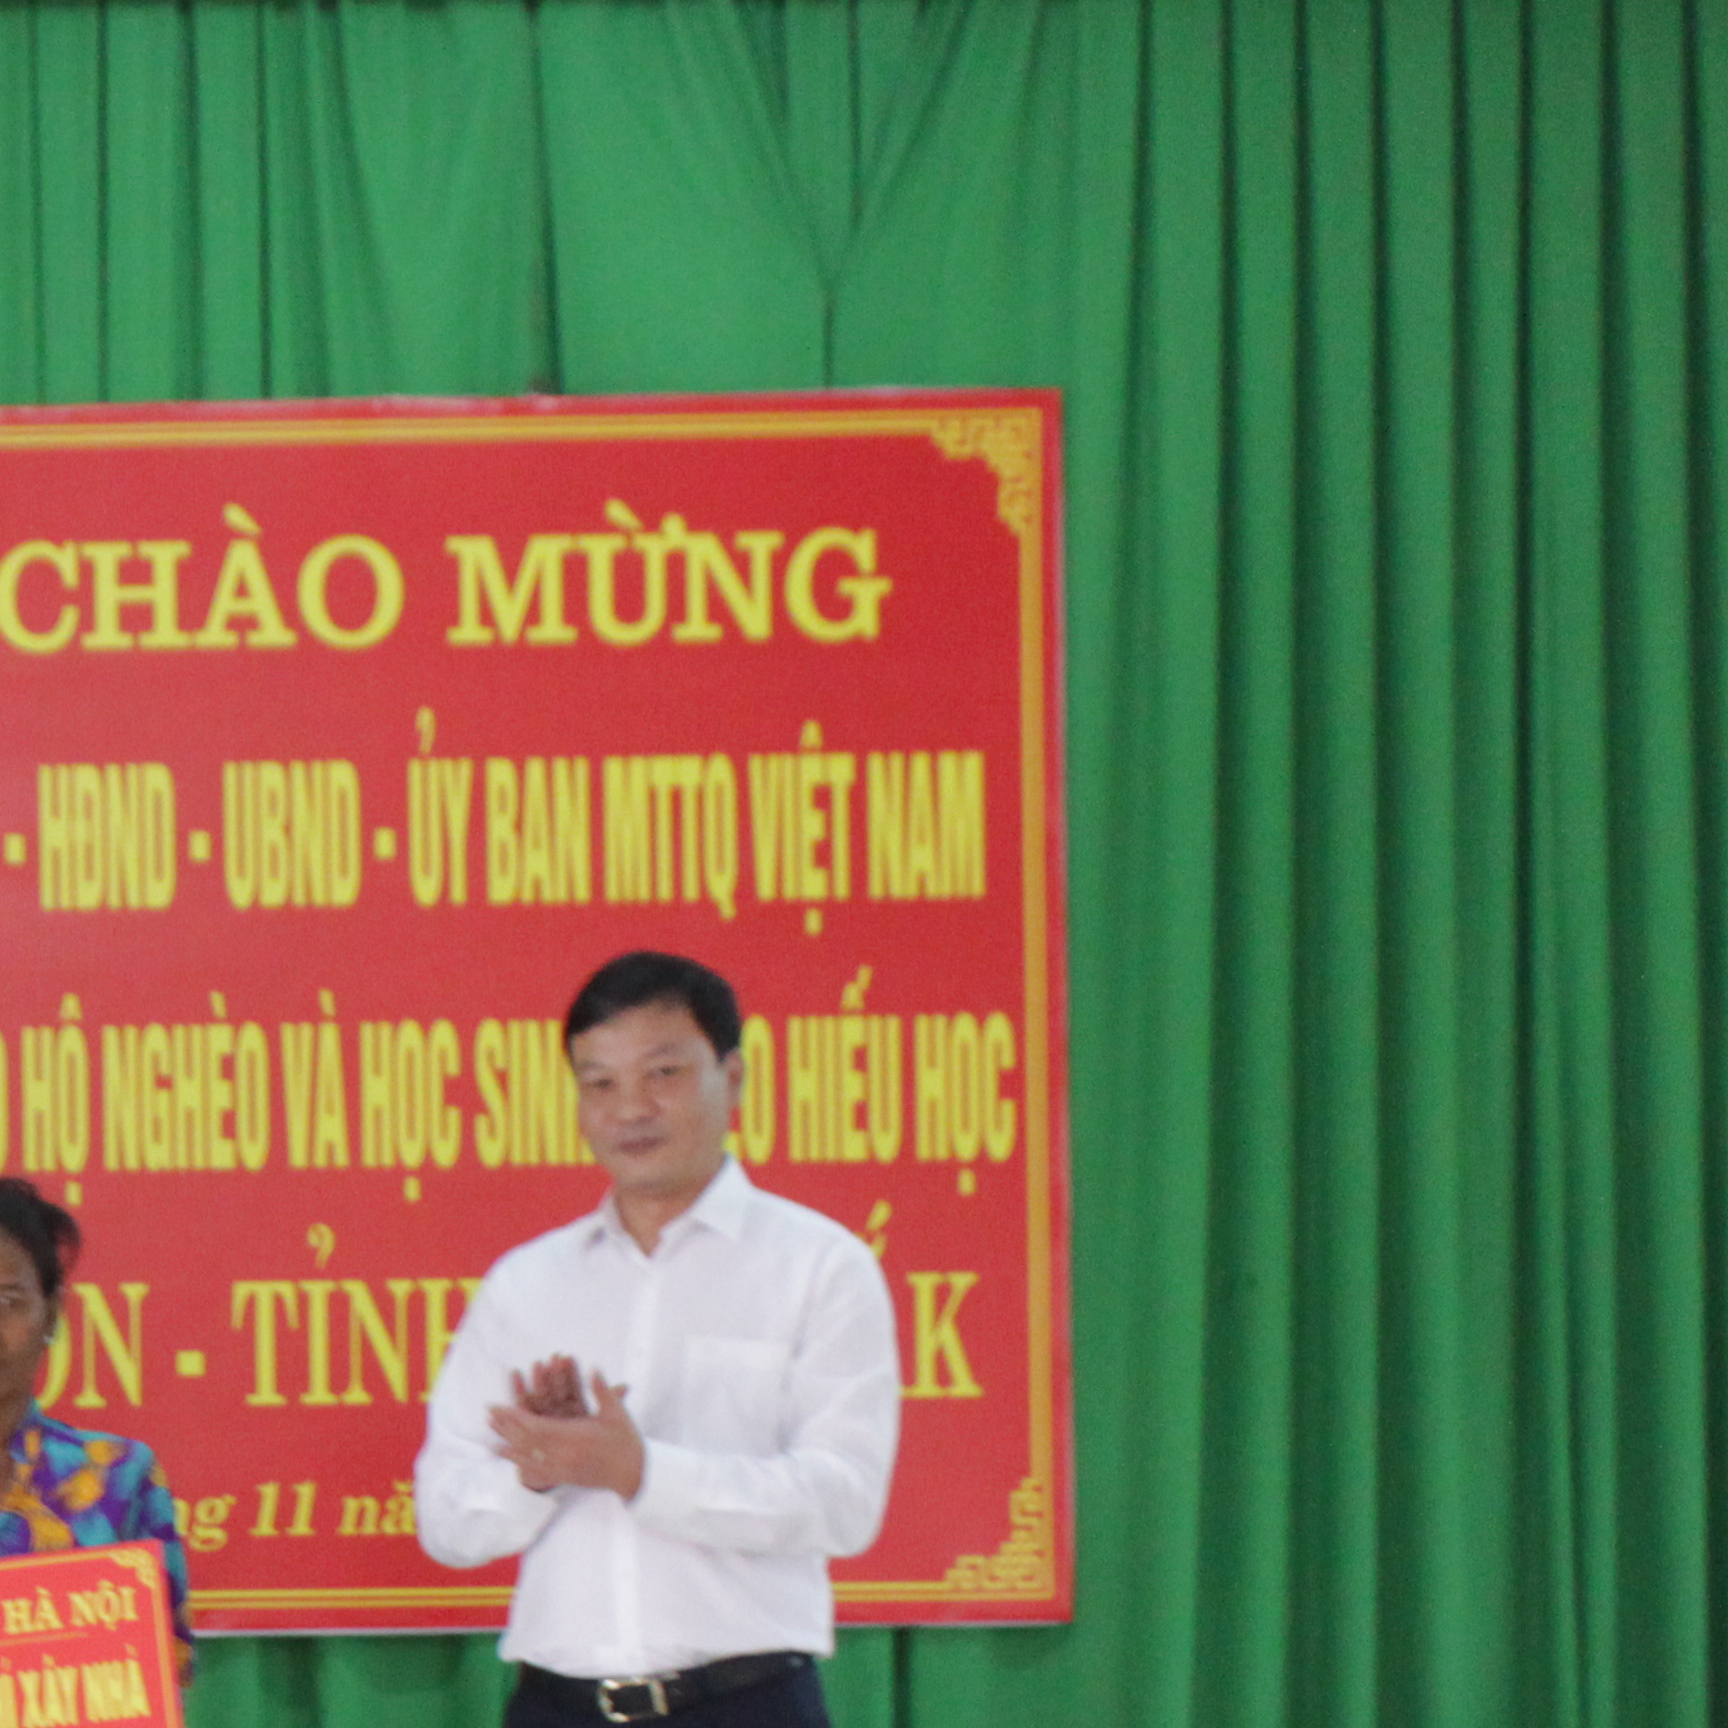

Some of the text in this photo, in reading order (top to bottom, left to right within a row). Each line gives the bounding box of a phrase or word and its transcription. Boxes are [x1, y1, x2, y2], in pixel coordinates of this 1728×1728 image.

[446, 500, 890, 645] MỪNG
[37, 763, 176, 912] HĐND
[223, 760, 361, 910] UBND
[408, 708, 472, 907] ỦY
[486, 757, 591, 904] BAN
[603, 754, 737, 918] MTTQ
[749, 722, 855, 933] VIỆT
[868, 752, 984, 898] NAM
[21, 994, 90, 1206] HỘ
[102, 992, 270, 1171] NGHÈO
[281, 990, 349, 1168] VÀ
[360, 1019, 461, 1201] HỌC
[788, 968, 901, 1162] HIẾU
[915, 1013, 1018, 1194] HỌC
[252, 1483, 314, 1536] 11
[340, 1483, 417, 1534] nă
[2, 1587, 63, 1634] HÀ
[69, 1580, 139, 1631] NỘI
[81, 1646, 151, 1722] NHÀ
